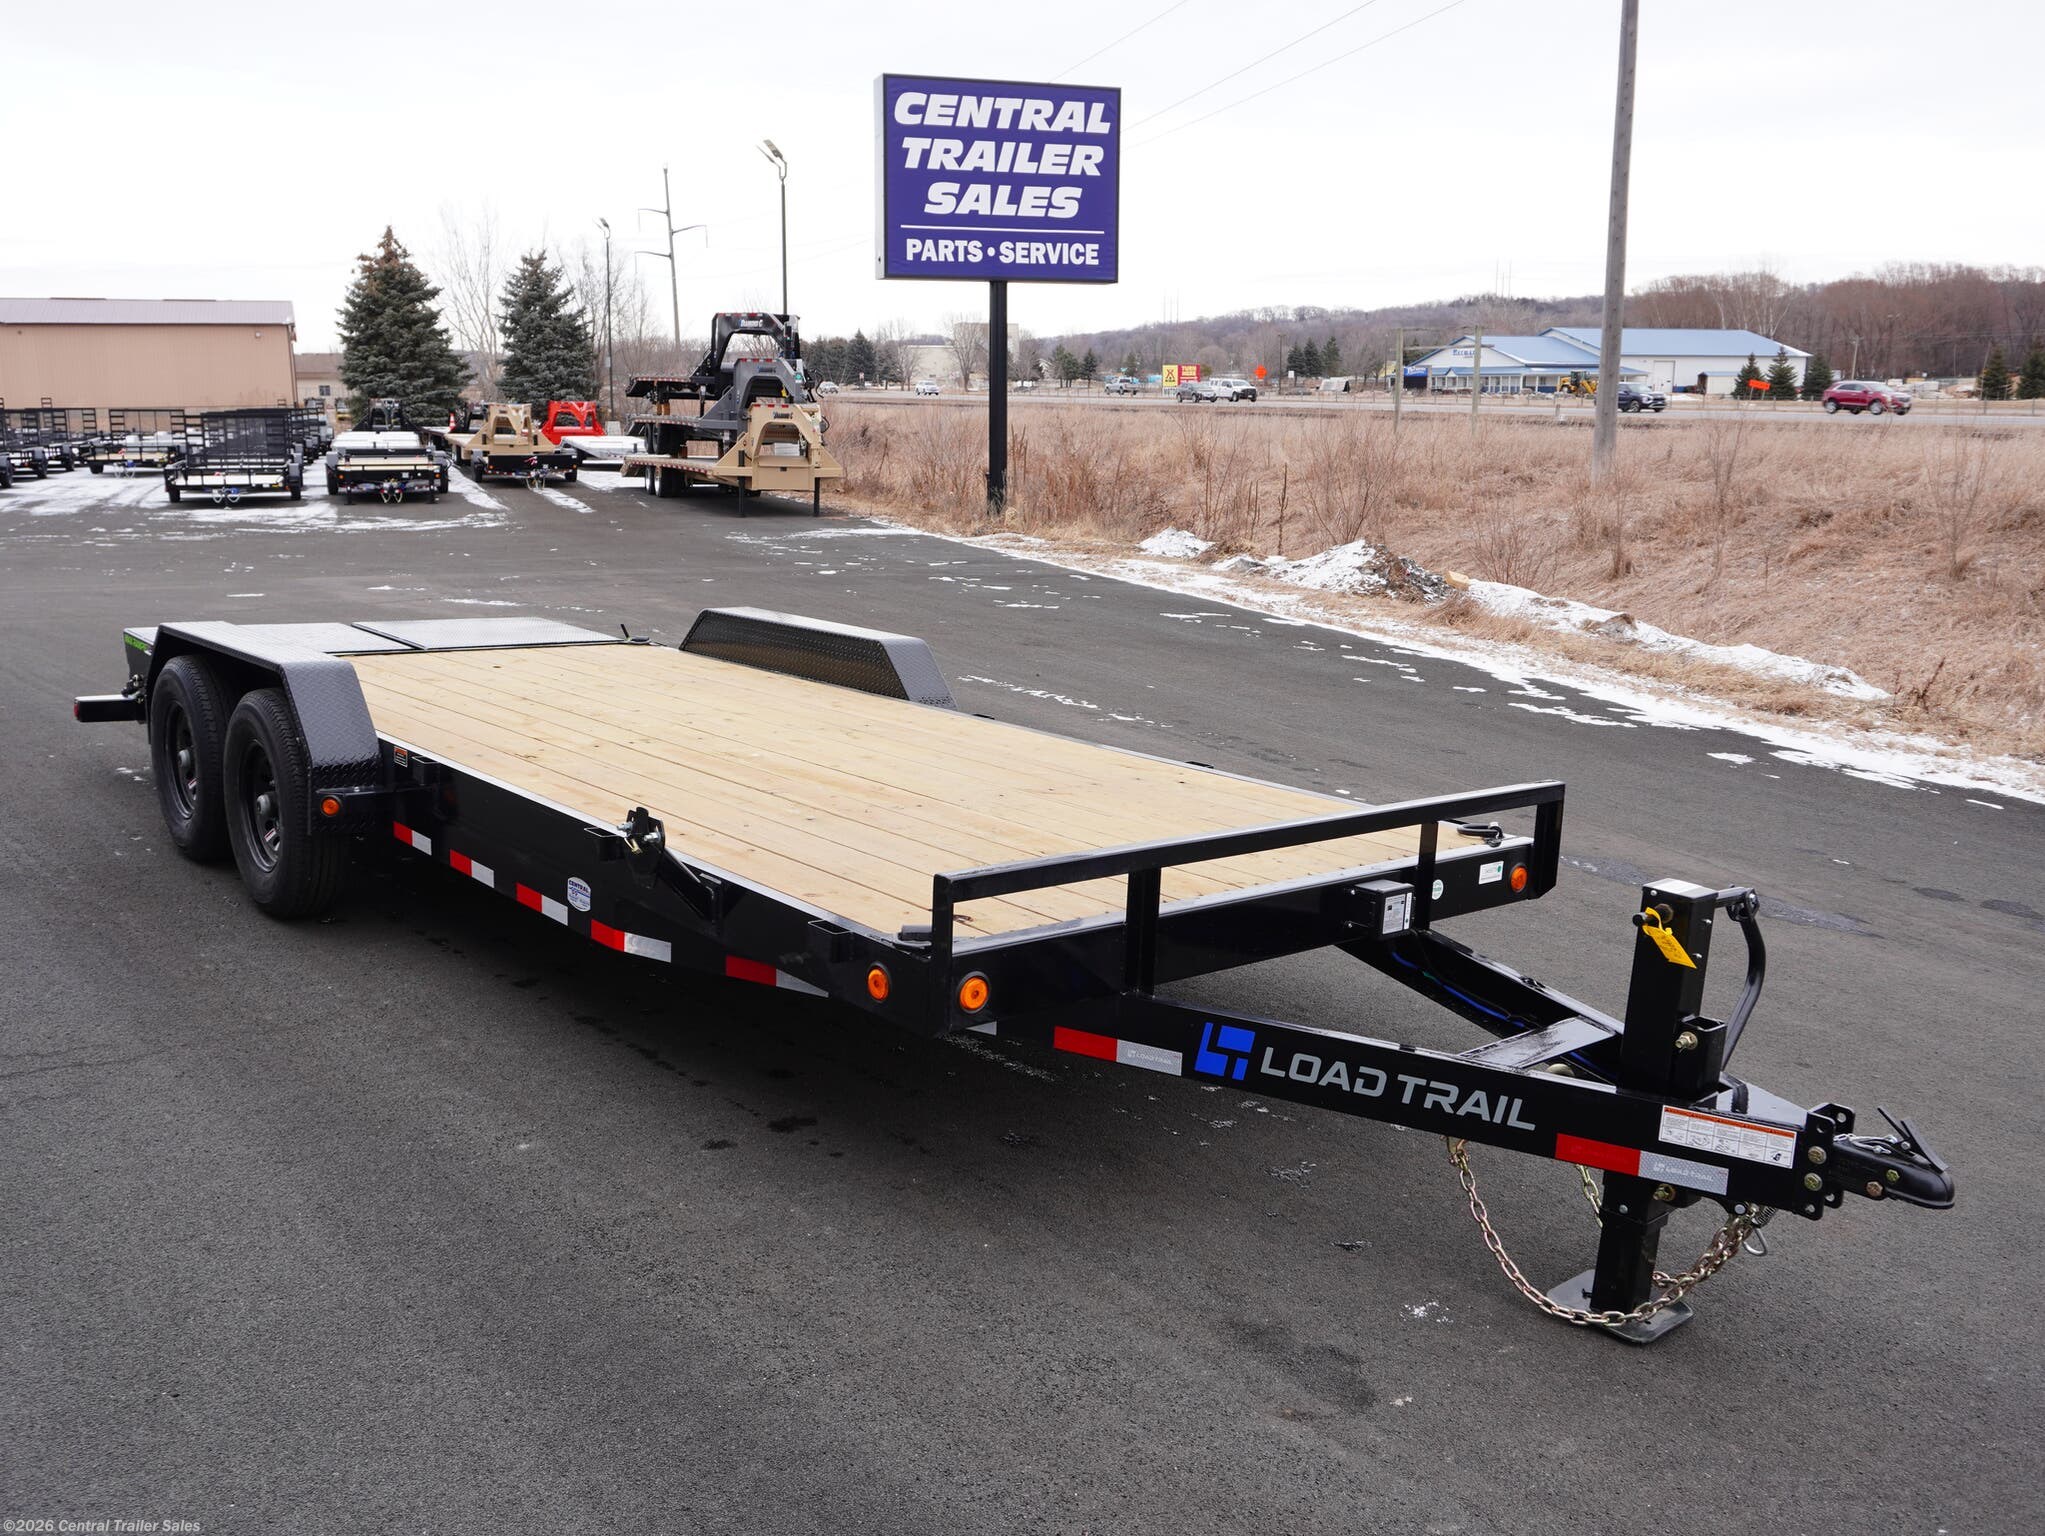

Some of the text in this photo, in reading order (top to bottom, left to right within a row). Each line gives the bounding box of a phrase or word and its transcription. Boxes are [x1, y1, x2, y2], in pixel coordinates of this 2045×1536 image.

[894, 91, 1111, 134] CENTRAL
[901, 137, 1105, 177] TRAILER
[923, 181, 1083, 219] SALES
[905, 238, 1100, 266] PARTS SERVICE
[1260, 1046, 1536, 1131] LOAD TRAIL
